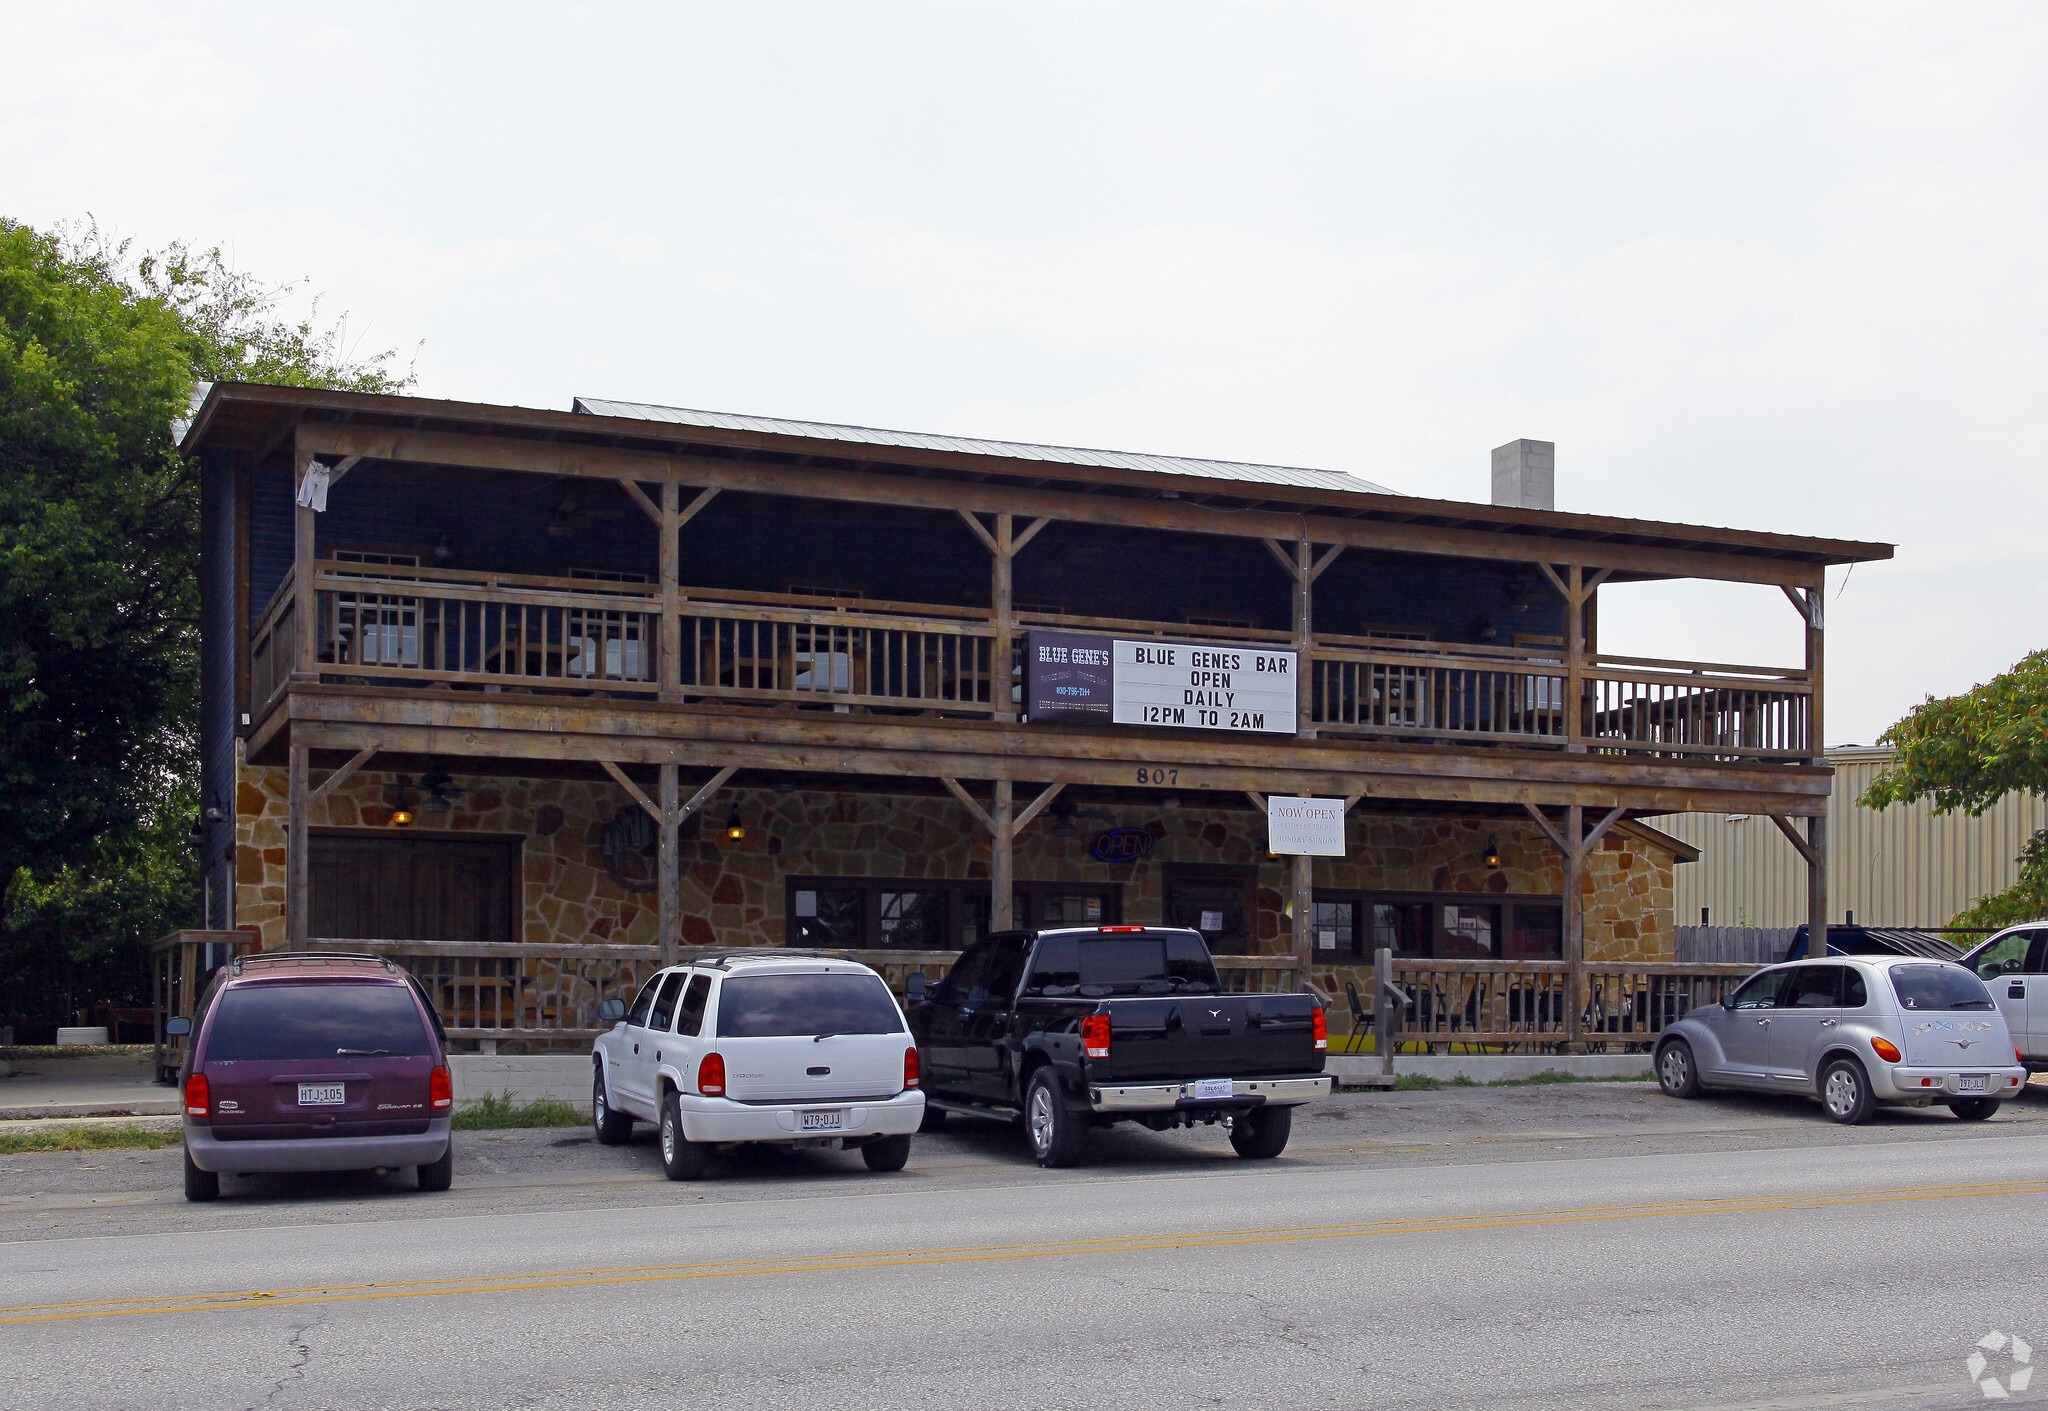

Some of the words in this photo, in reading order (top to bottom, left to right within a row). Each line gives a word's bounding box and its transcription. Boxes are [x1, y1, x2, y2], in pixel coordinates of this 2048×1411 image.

[1039, 646, 1068, 664] BLUE
[1071, 648, 1109, 666] GENE'S
[1135, 647, 1176, 666] BLUE
[1191, 651, 1241, 670] GENES
[1256, 656, 1288, 674] BAR
[1190, 670, 1231, 689] OPEN
[1184, 689, 1235, 708] DAILY
[1143, 706, 1185, 724] 12PM
[1198, 709, 1218, 727] TO
[1230, 712, 1264, 729] 2AM
[1136, 767, 1179, 785] 807
[1278, 806, 1304, 819] NOW
[1305, 808, 1336, 820] OPEN
[1097, 834, 1148, 856] OPEN
